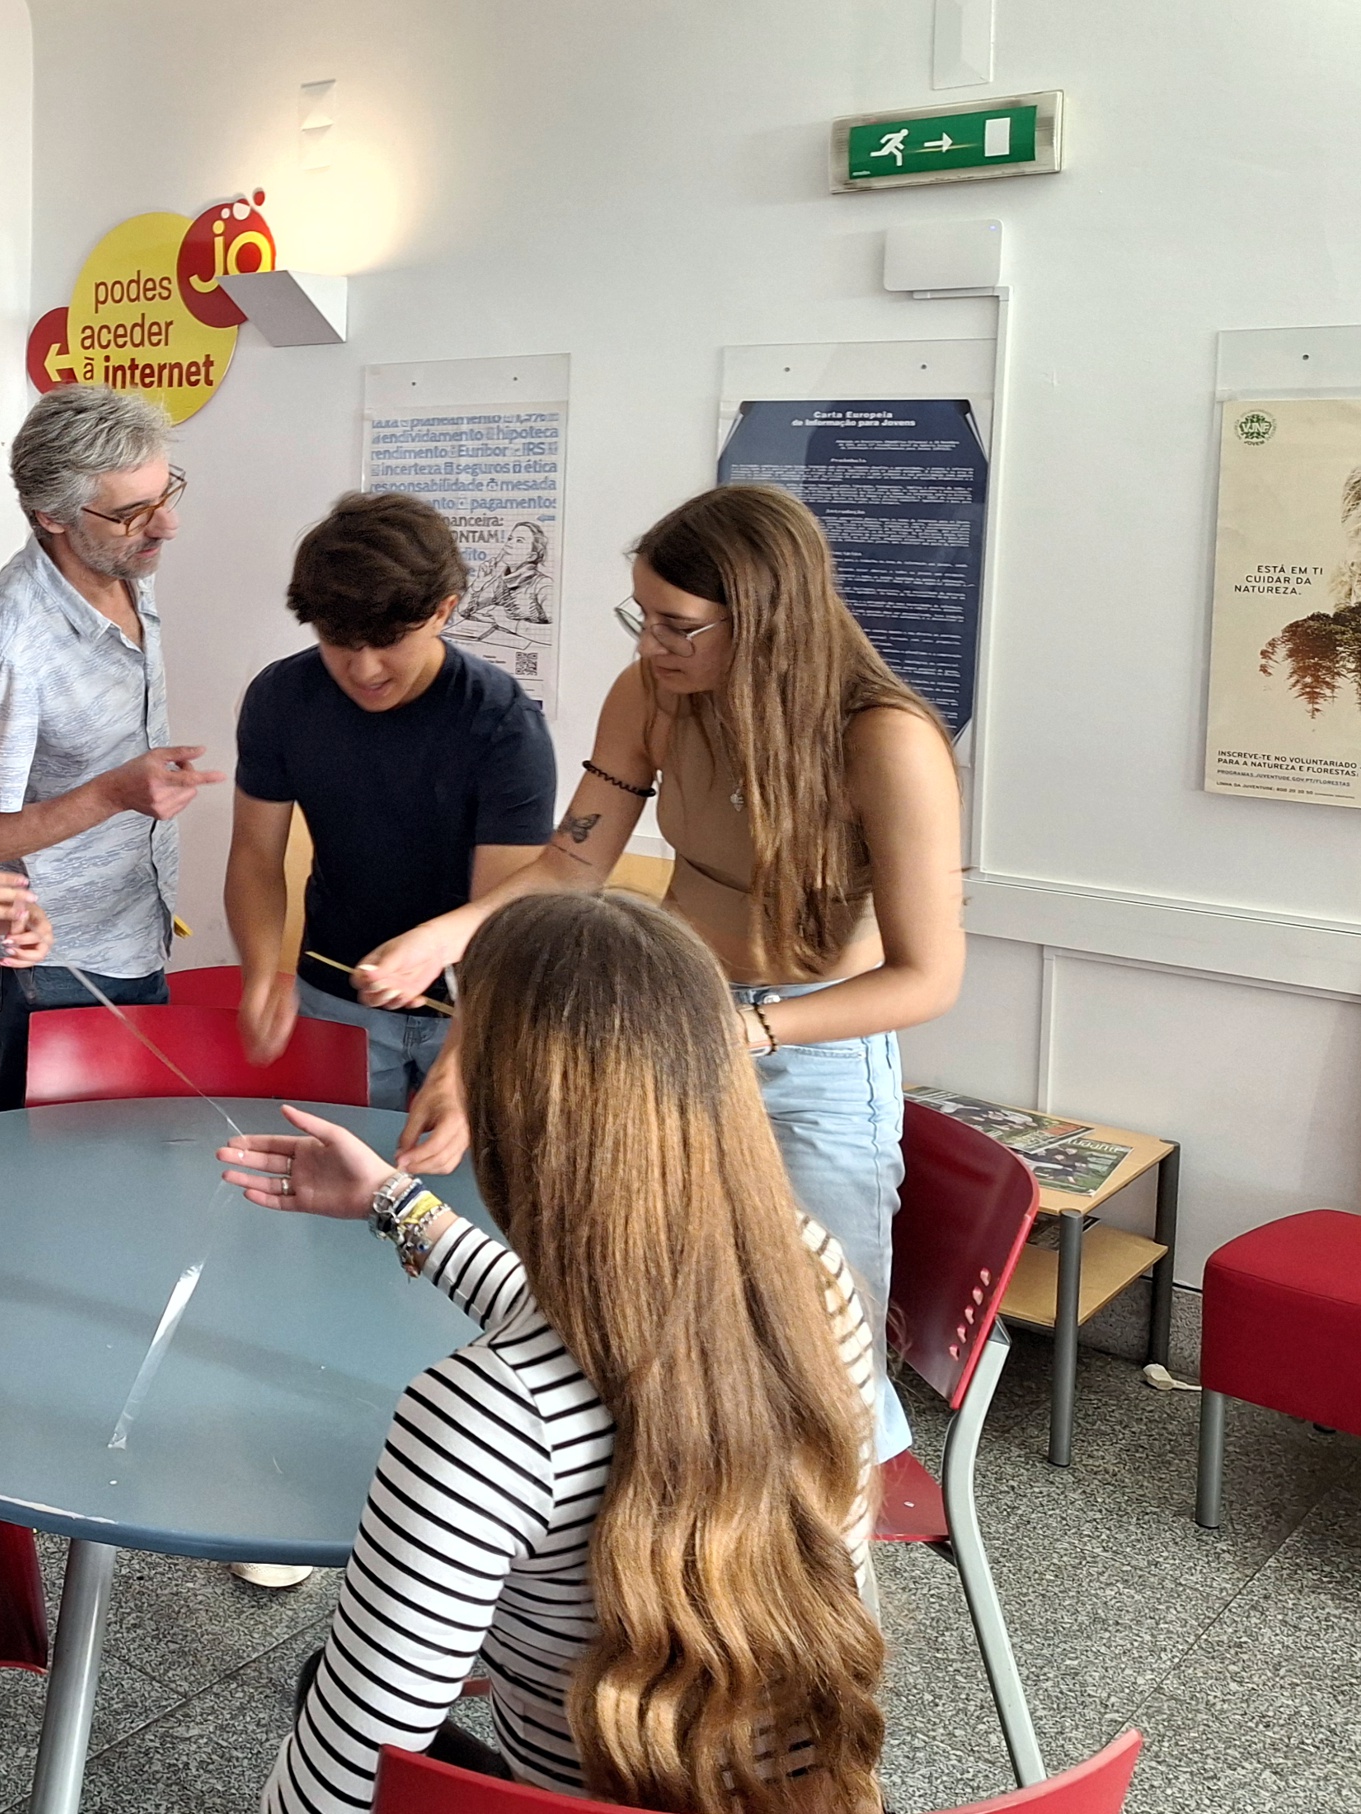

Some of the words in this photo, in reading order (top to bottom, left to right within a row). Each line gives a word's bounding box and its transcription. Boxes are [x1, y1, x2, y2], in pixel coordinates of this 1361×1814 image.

[94, 270, 172, 314] podes
[80, 313, 174, 350] aceder
[83, 357, 94, 381] à
[103, 354, 215, 389] internet
[813, 411, 843, 419] Carta
[845, 411, 893, 420] Europeia
[497, 425, 558, 444] hipoteca
[371, 445, 448, 460] rendimento
[458, 443, 509, 457] Euribor
[381, 462, 442, 476] incerteza
[455, 463, 510, 477] seguros
[524, 459, 557, 473] ética
[501, 476, 556, 491] mesada
[1257, 564, 1285, 574] ESTÁ
[1291, 566, 1307, 575] EM
[1312, 567, 1323, 575] TI
[1245, 575, 1291, 584] CUIDAR
[1296, 577, 1312, 585] DA
[1234, 585, 1302, 595] NATUREZA.
[1217, 757, 1240, 766] PARA
[1250, 761, 1296, 771] NATUREZA
[1218, 750, 1271, 761] INSCREVE-TE
[1274, 755, 1287, 763] NO
[1289, 756, 1357, 769] VOLUNTARIADO
